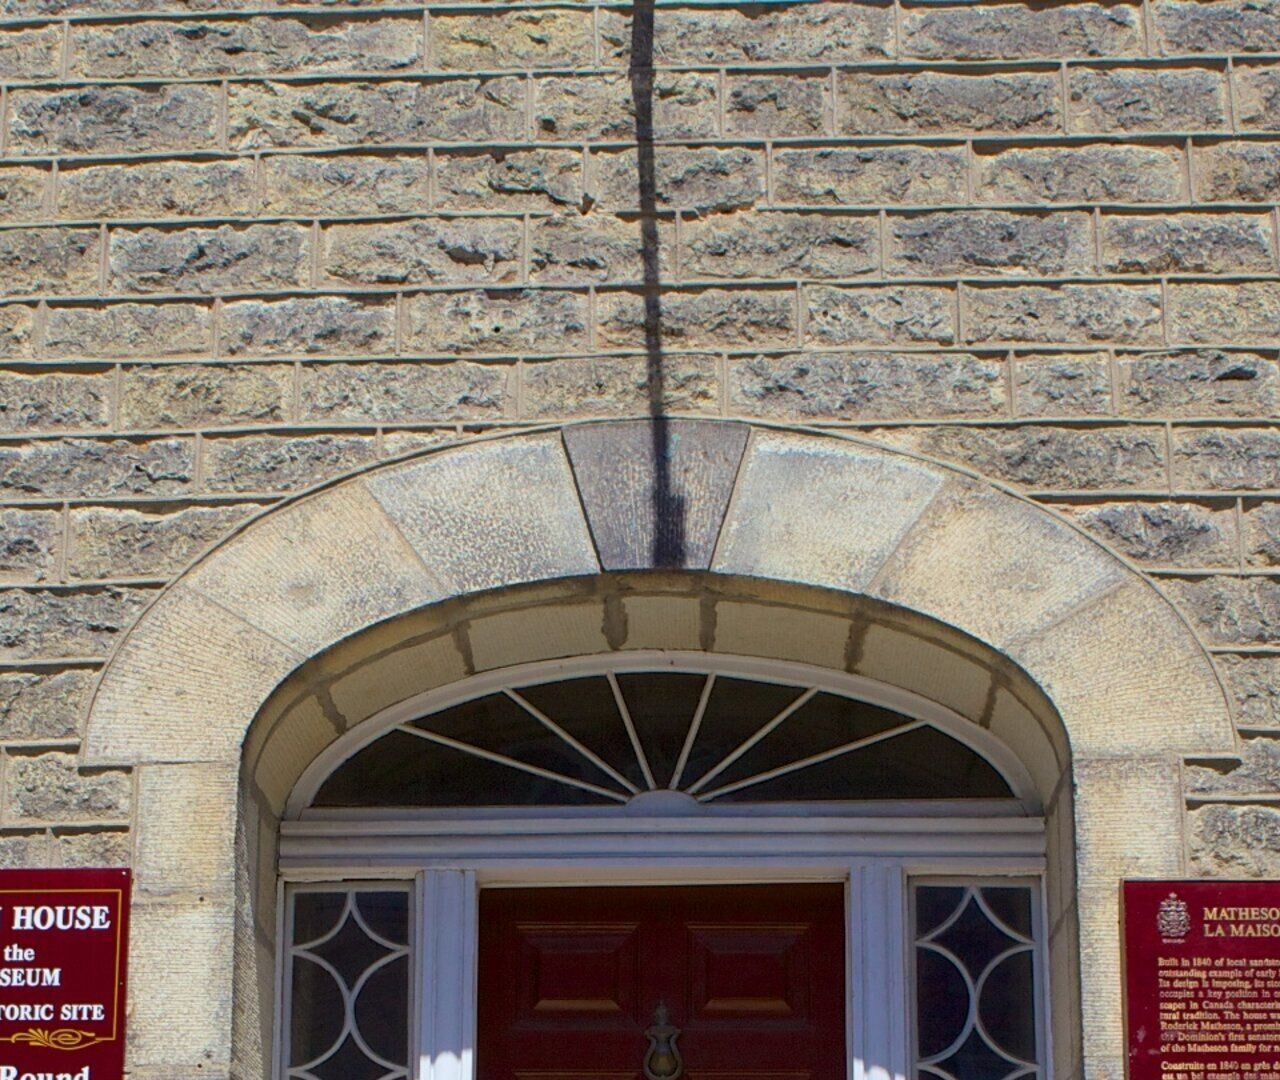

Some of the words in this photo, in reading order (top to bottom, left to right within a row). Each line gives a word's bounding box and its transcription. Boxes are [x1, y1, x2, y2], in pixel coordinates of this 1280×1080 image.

[12, 906, 110, 930] HOUSE
[1204, 923, 1225, 937] LA
[4, 944, 34, 961] the
[61, 1004, 104, 1020] SITE
